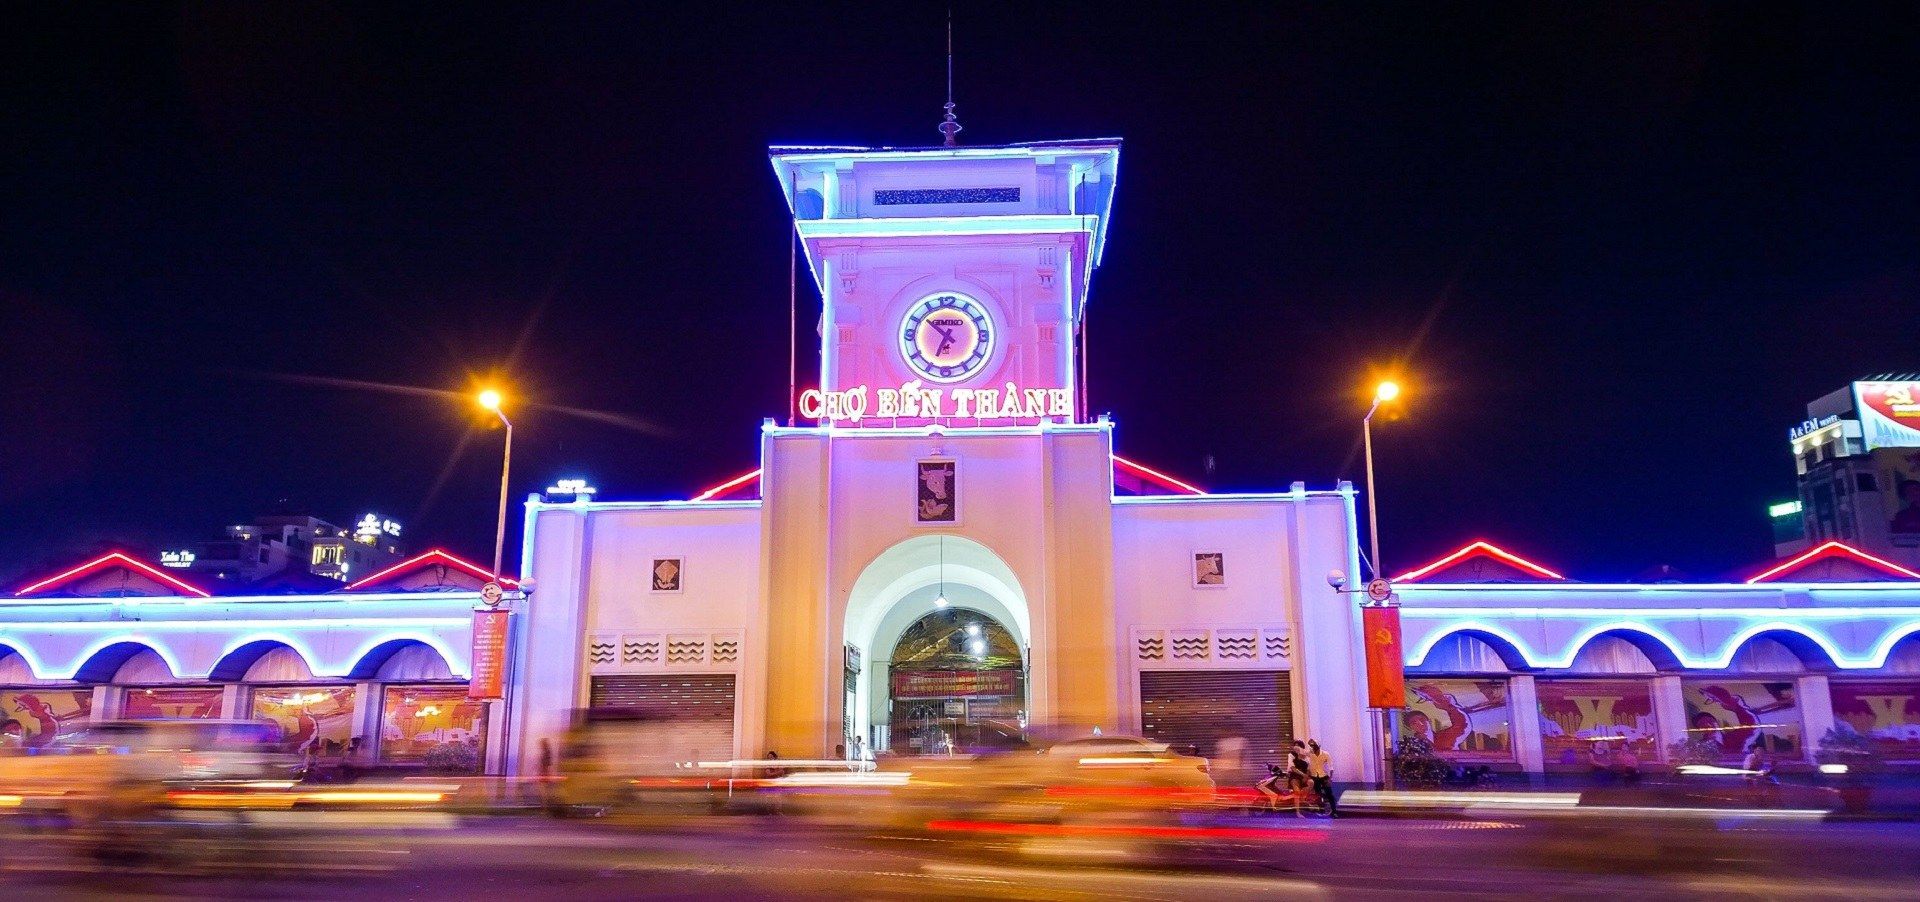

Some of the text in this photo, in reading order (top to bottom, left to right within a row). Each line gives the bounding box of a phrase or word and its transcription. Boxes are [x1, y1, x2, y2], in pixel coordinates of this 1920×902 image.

[938, 296, 956, 307] 12
[979, 329, 990, 342] 3
[799, 380, 1073, 421] CHỢ BẾN THÀNH
